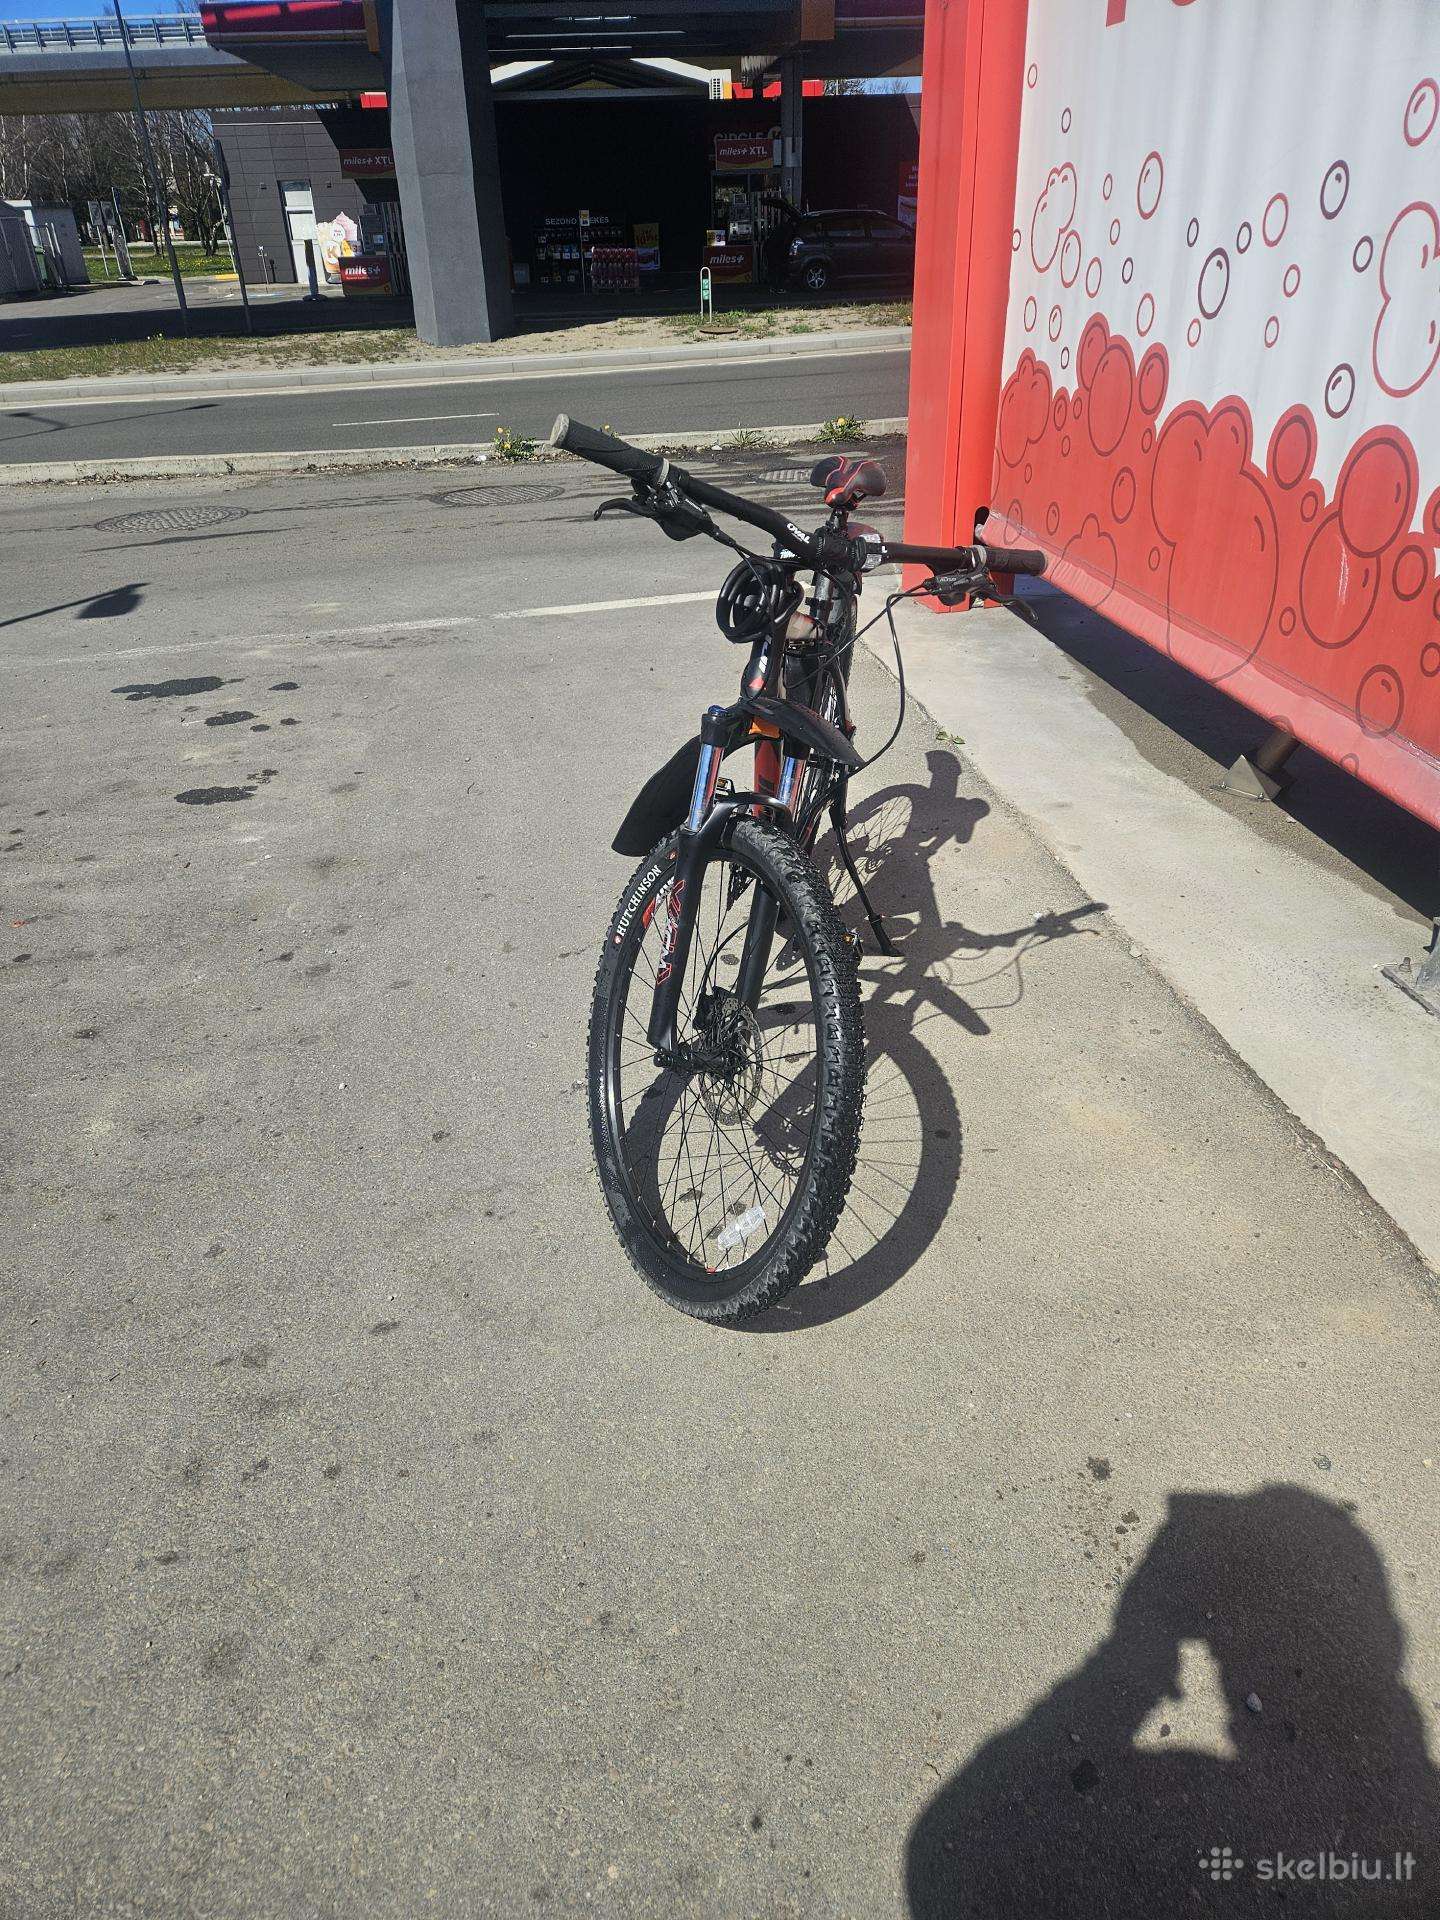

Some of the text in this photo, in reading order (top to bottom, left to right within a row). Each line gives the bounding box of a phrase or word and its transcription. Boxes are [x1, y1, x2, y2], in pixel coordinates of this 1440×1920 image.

[749, 146, 768, 155] XTL
[374, 155, 394, 165] XTL
[786, 522, 811, 544] OVAL
[616, 864, 662, 937] HUTCHINSON
